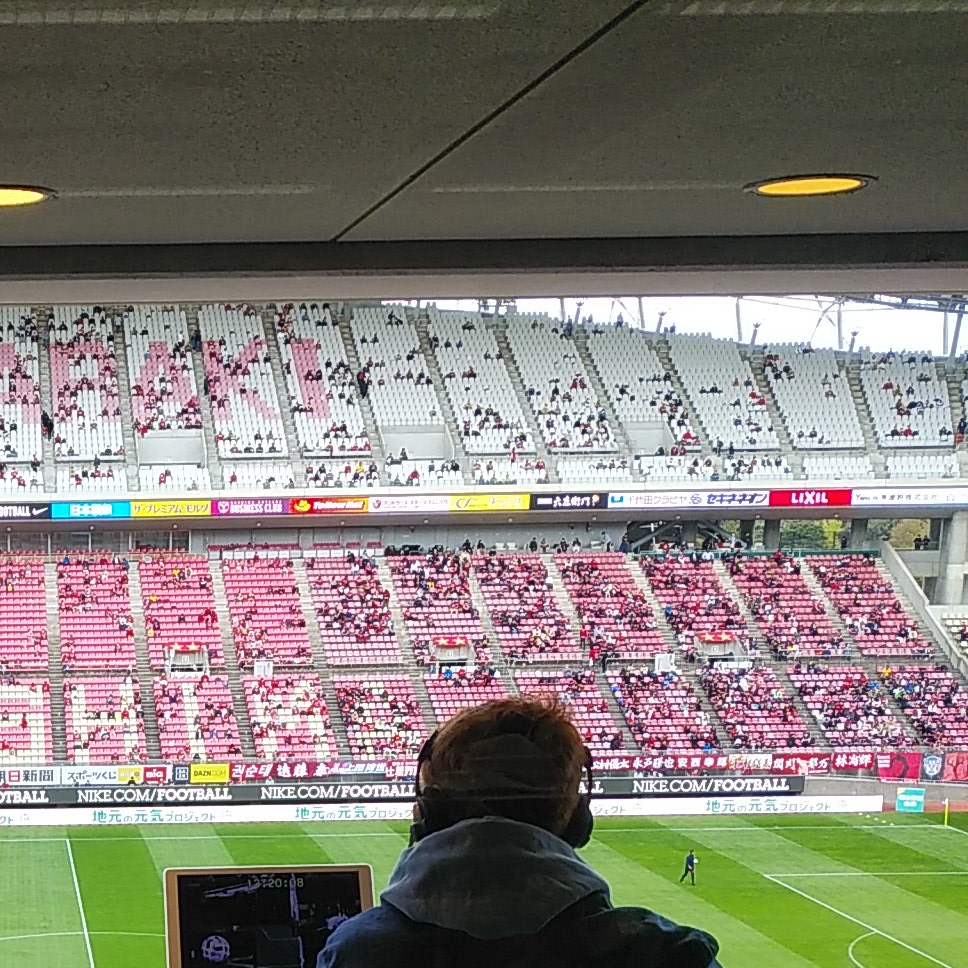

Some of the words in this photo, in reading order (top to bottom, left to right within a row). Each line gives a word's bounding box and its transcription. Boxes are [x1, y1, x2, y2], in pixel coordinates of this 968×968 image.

[791, 490, 829, 504] LIXIL
[67, 770, 117, 780] スポーツくじ
[632, 778, 790, 794] NIKE.COM/FOOTBALL
[78, 788, 232, 803] NIKE.COM/FOOTBALL
[706, 798, 831, 812] 地元の元気プロジェクト
[92, 809, 216, 823] 地元の元気プロジェクト
